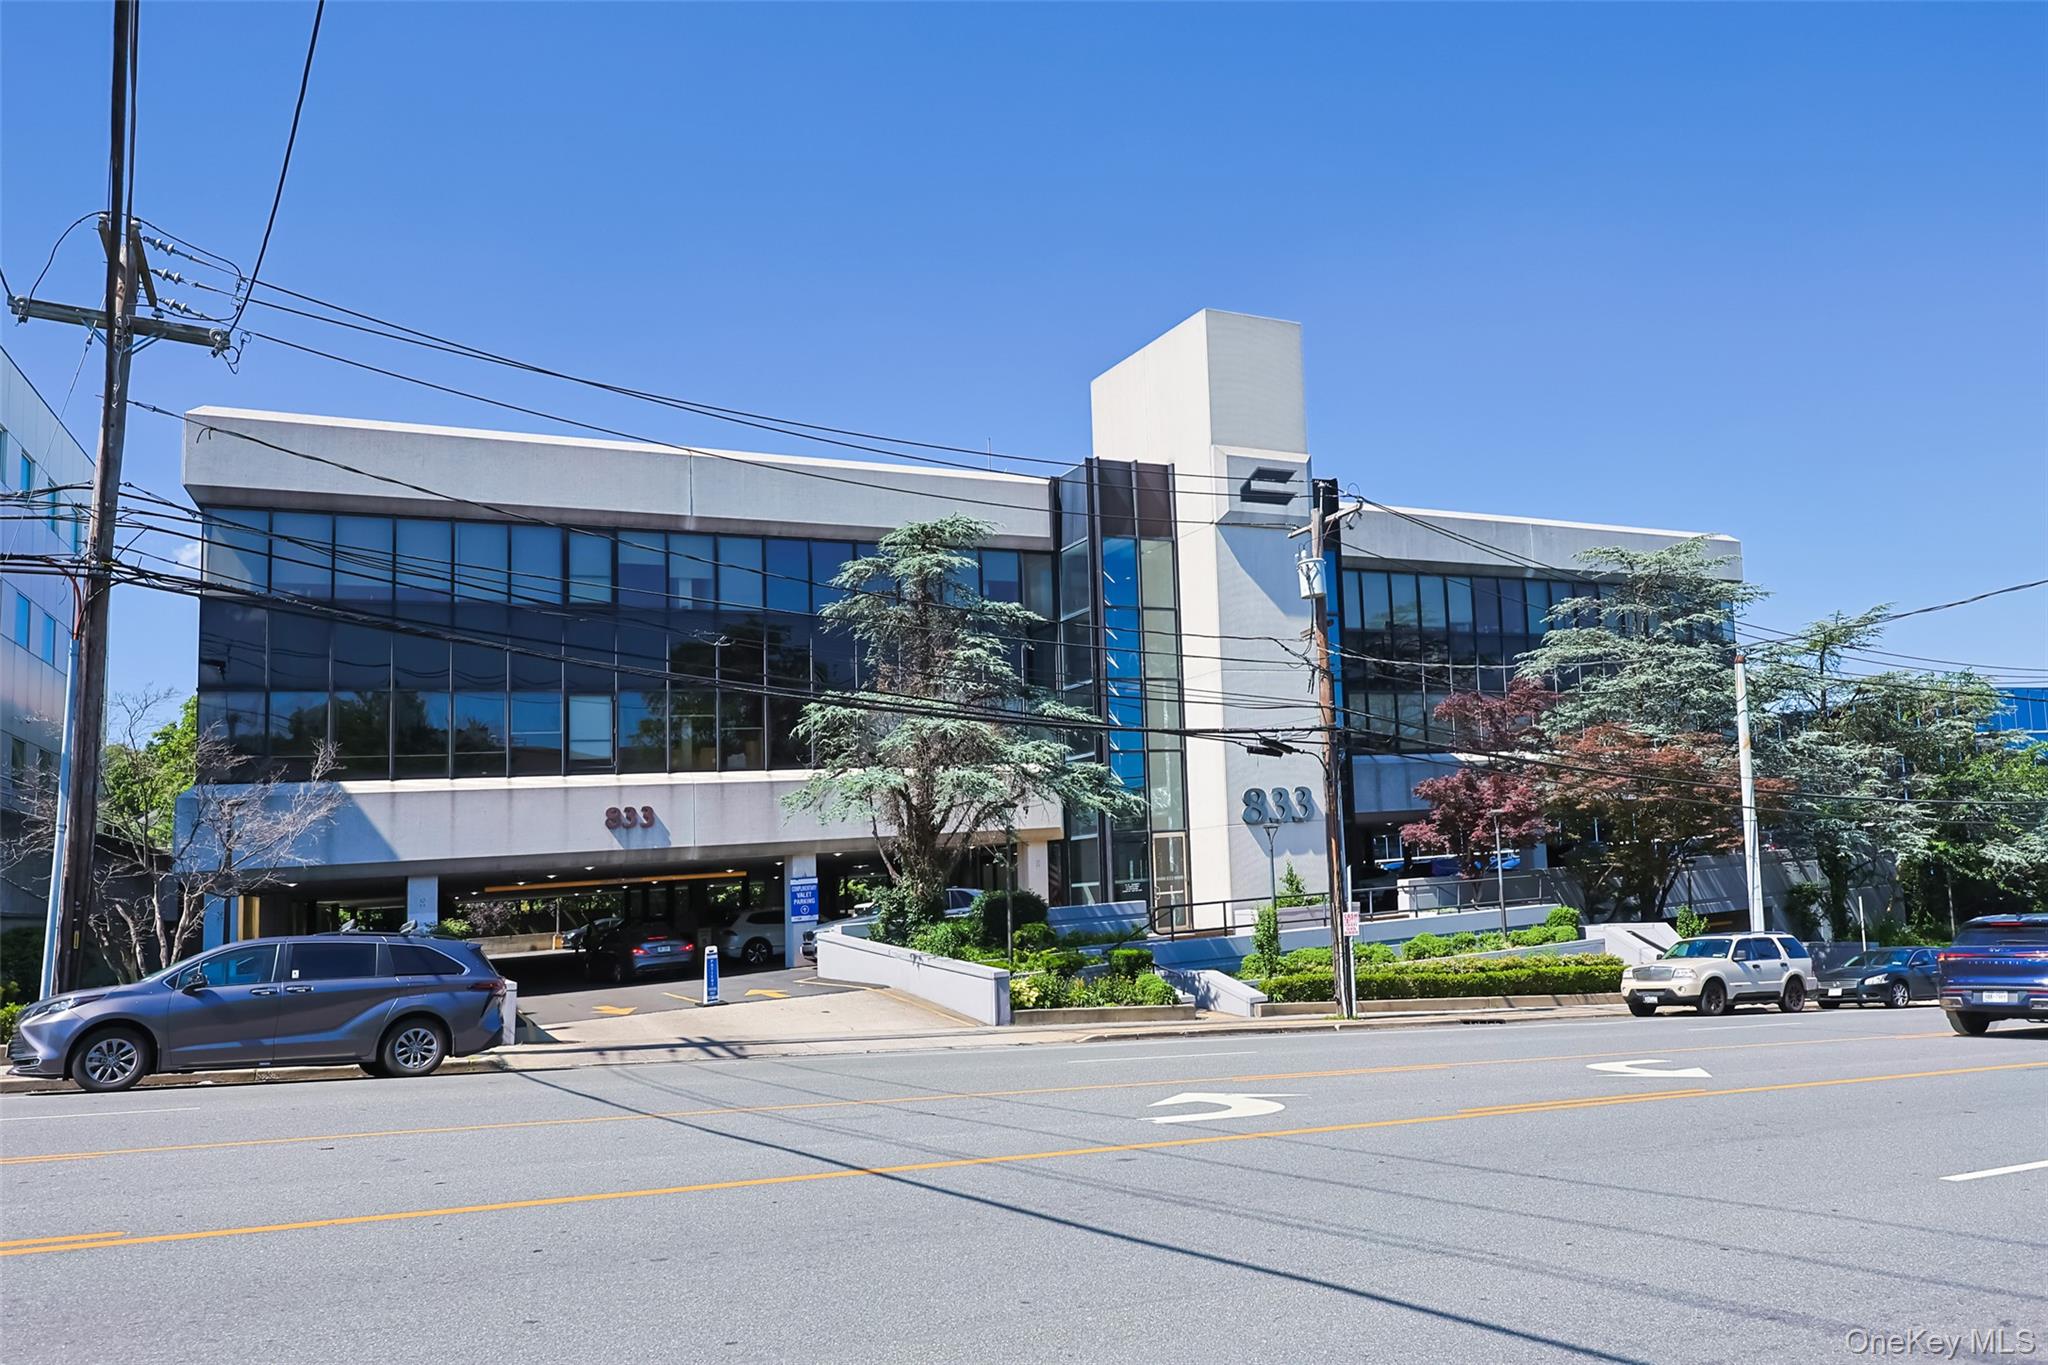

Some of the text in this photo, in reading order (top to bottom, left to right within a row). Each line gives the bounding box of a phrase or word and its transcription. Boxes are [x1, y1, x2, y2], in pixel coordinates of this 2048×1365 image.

[1242, 786, 1316, 825] 833
[605, 806, 655, 830] 833
[793, 897, 816, 905] PARKING
